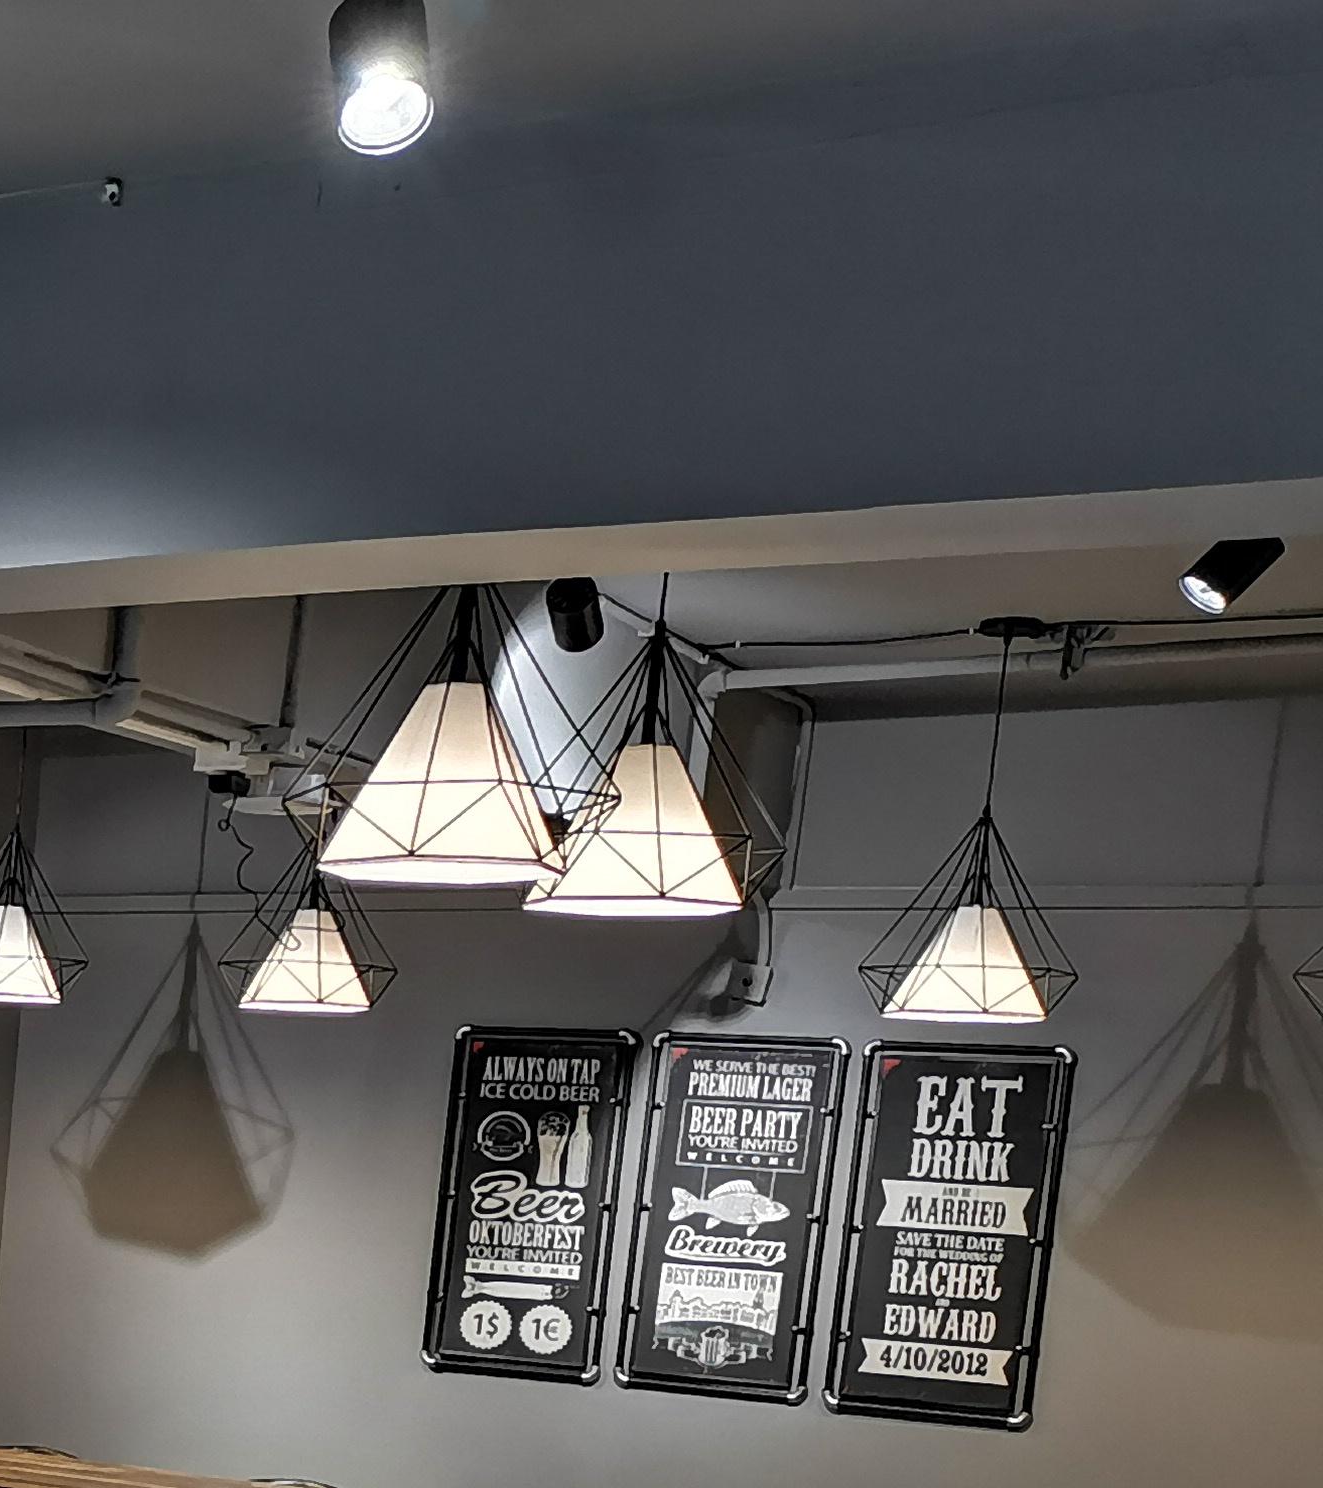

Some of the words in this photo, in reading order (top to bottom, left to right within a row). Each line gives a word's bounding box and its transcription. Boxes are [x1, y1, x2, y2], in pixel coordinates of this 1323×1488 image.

[482, 1056, 545, 1082] ALWAYS
[547, 1058, 568, 1083] ON
[571, 1059, 601, 1084] TAP
[693, 1059, 713, 1071] WE
[716, 1060, 753, 1074] SERVE
[756, 1062, 780, 1075] THE
[479, 1082, 506, 1099] ICE
[509, 1083, 556, 1100] COLD
[559, 1085, 600, 1102] BEER
[687, 1072, 760, 1099] PREMIUM
[762, 1076, 813, 1101] LAGER
[912, 1075, 1023, 1138] EAT
[689, 1105, 737, 1135] BEER
[740, 1109, 803, 1139] PARTY
[688, 1134, 739, 1149] YOU'RE
[741, 1137, 798, 1153] INVITED
[687, 1151, 795, 1167] WELCOME
[907, 1138, 1015, 1182] DRINK
[471, 1171, 584, 1222] Beer
[900, 1196, 1006, 1228] MARRIED
[468, 1220, 585, 1250] OKTOBERFEST
[669, 1229, 783, 1262] Brewery
[896, 1231, 932, 1247] SAVE
[934, 1233, 964, 1249] THE
[967, 1235, 1005, 1251] DATE
[466, 1244, 520, 1260] YOU'RE
[523, 1249, 583, 1265] INVITED
[471, 1261, 574, 1276] WELCOME
[665, 1267, 694, 1286] BEST
[696, 1269, 726, 1288] BEER
[888, 1258, 1002, 1301] RACHEL
[473, 1312, 499, 1339] 1$
[532, 1318, 561, 1341] 1€
[883, 1303, 996, 1343] EDWARD
[879, 1344, 989, 1376] 4/10/2012
